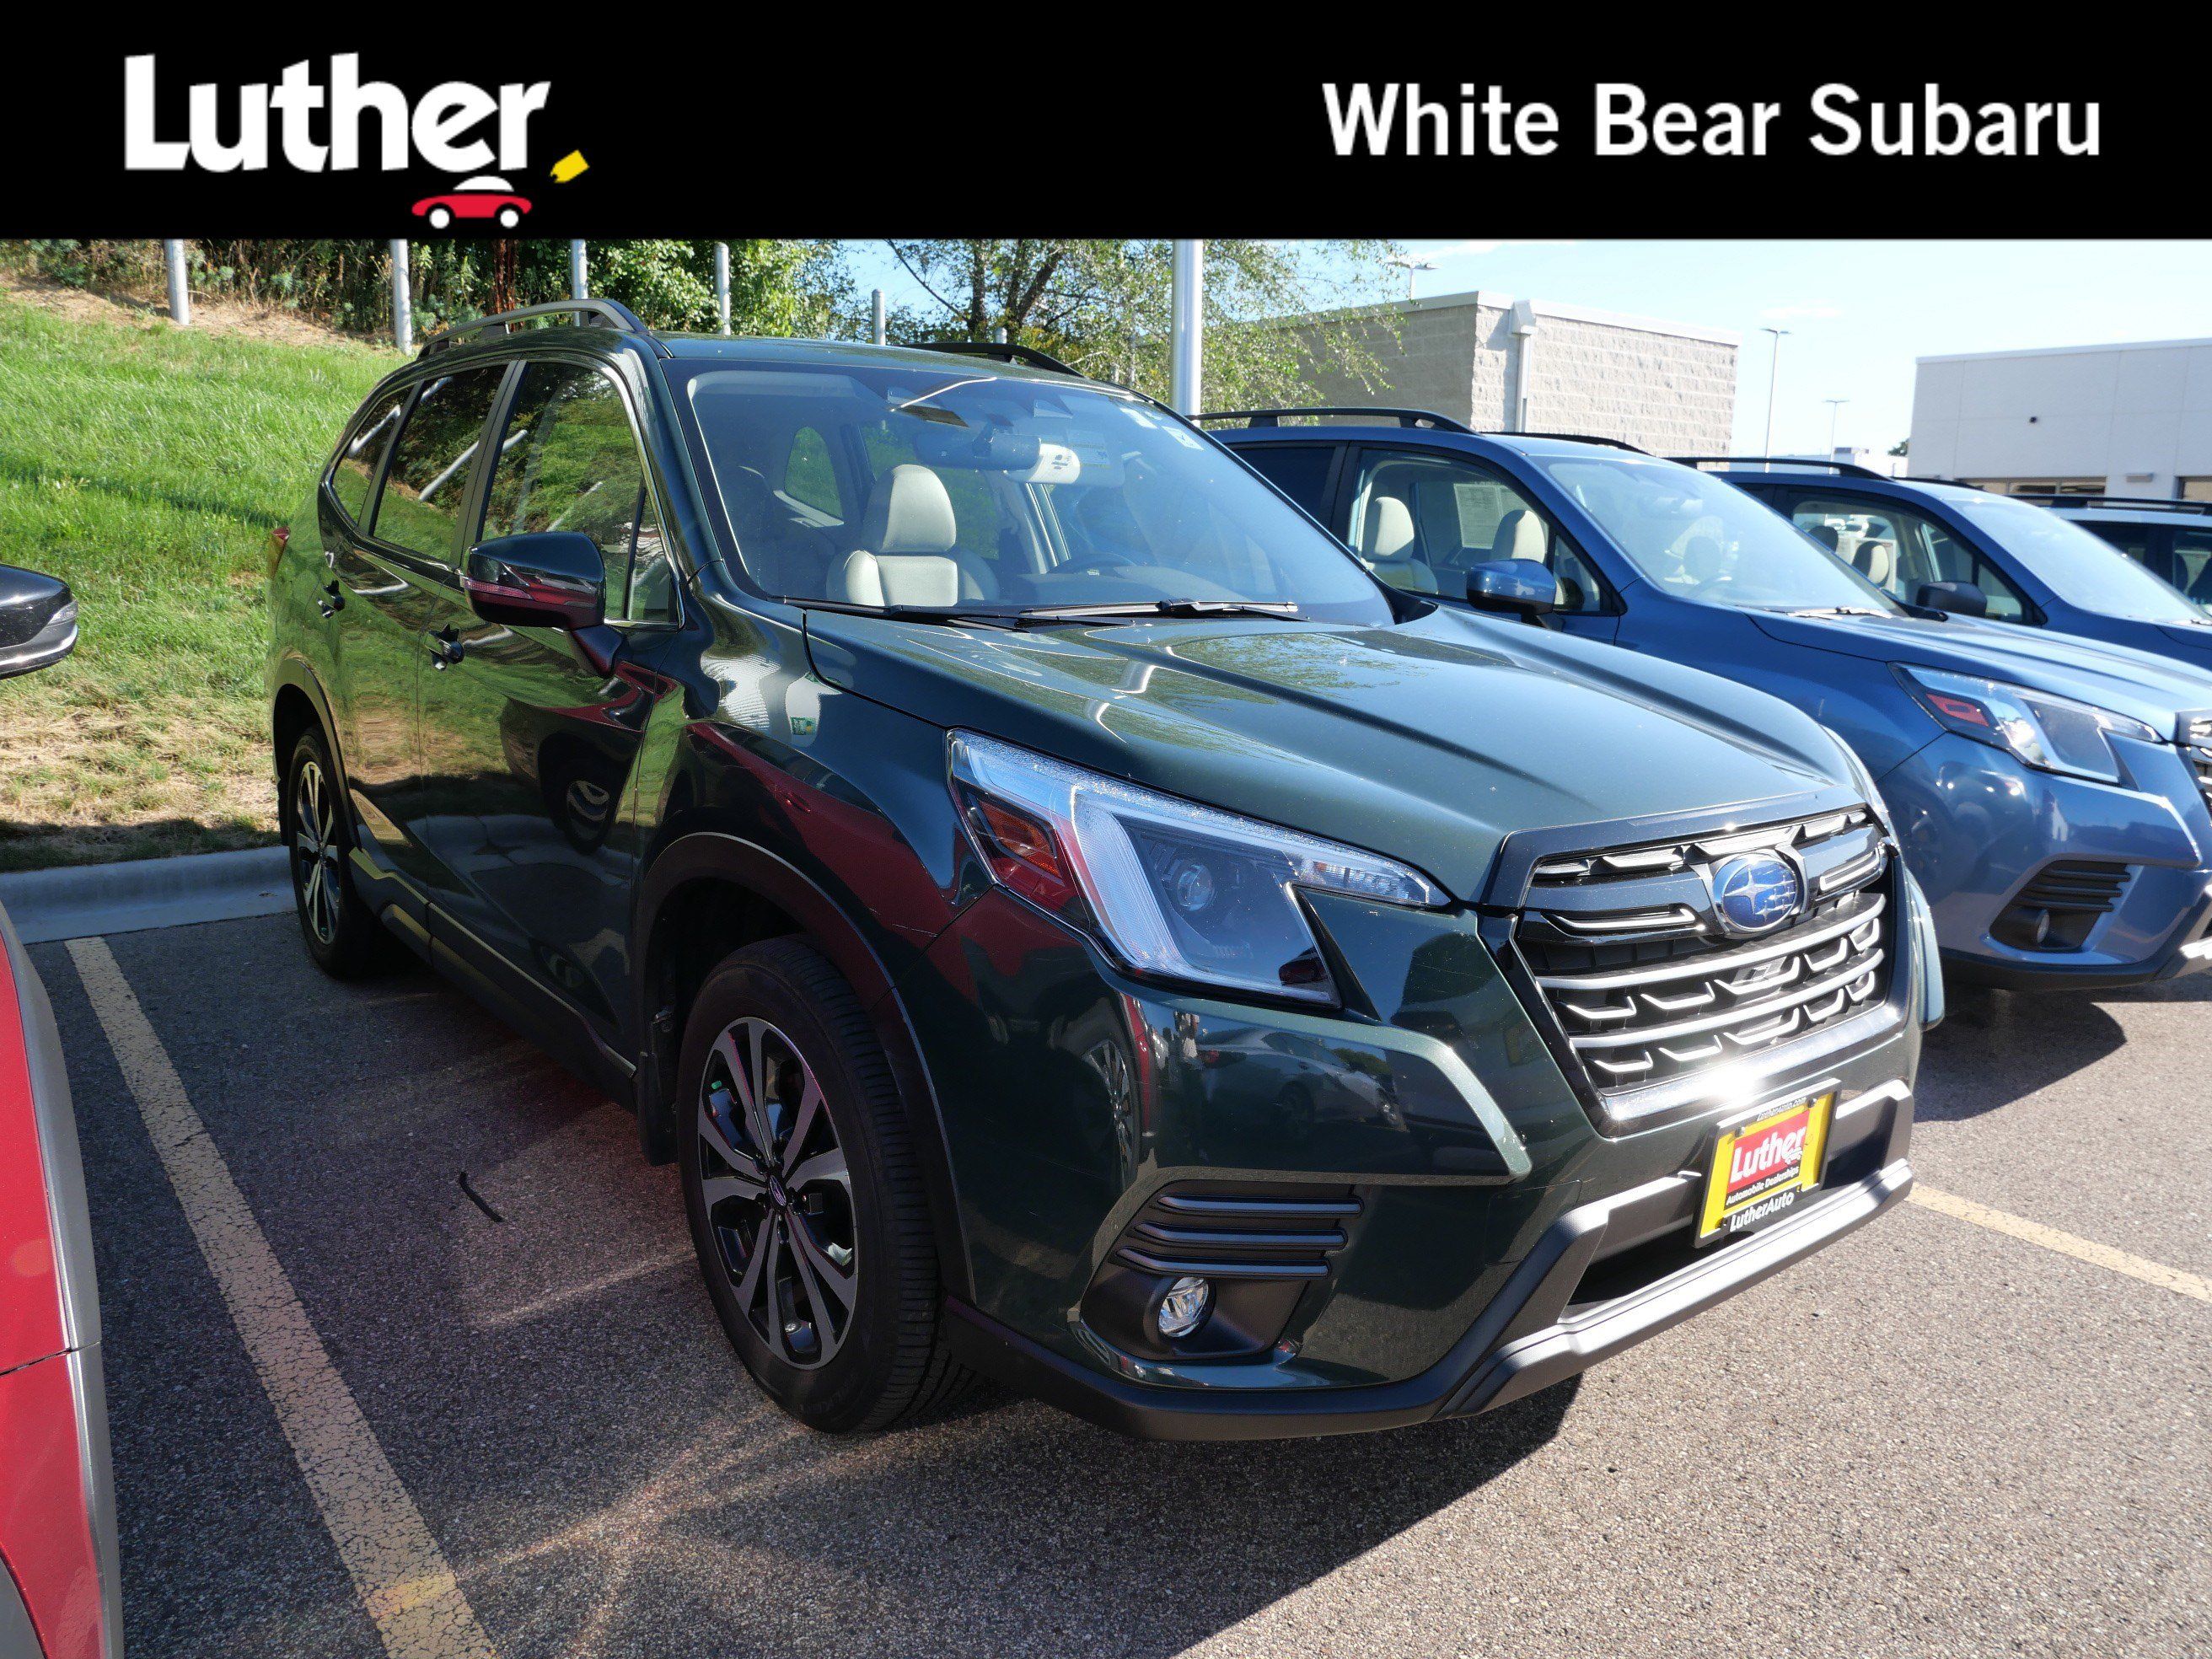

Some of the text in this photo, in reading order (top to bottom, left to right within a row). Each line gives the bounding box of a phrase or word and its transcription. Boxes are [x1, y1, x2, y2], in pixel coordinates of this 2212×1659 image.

[1730, 1126, 1807, 1183] Luther
[1725, 1166, 1800, 1205] Automobile Dealerships
[1729, 1191, 1796, 1232] LutherAuto
